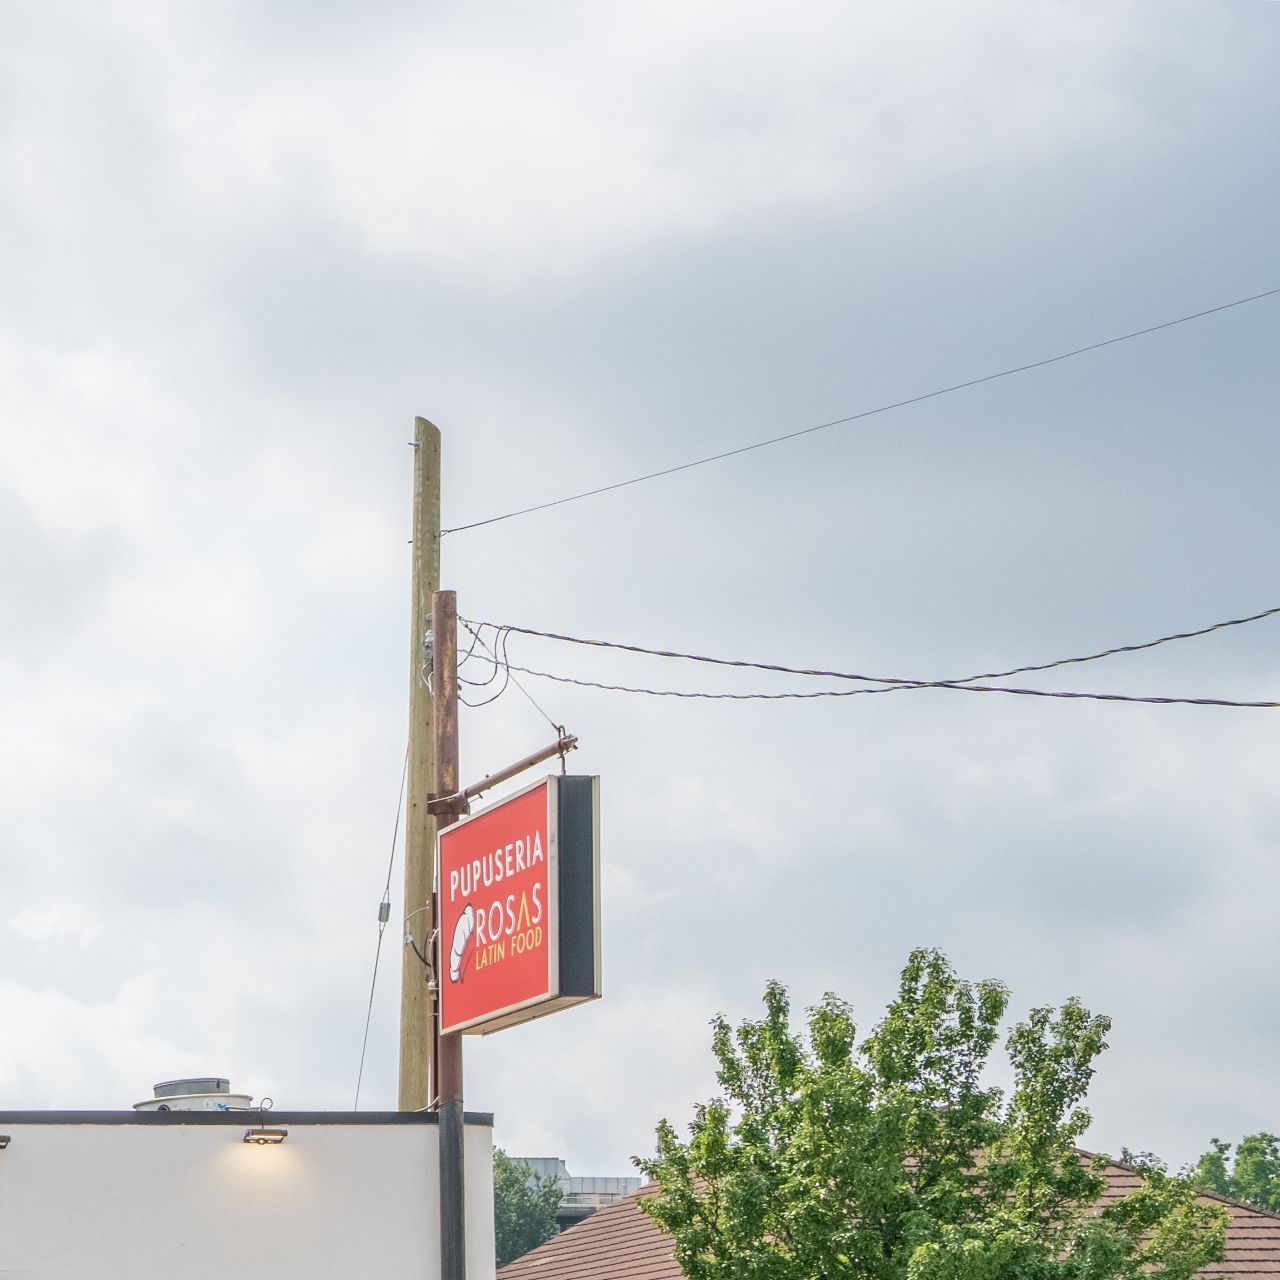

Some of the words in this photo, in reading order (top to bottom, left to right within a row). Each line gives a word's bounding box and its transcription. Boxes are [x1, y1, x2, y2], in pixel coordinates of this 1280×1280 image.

[450, 829, 544, 902] PUPUSERIA
[475, 882, 542, 948] ROSAS
[475, 940, 505, 971] LATIN
[511, 926, 542, 956] FOOD
